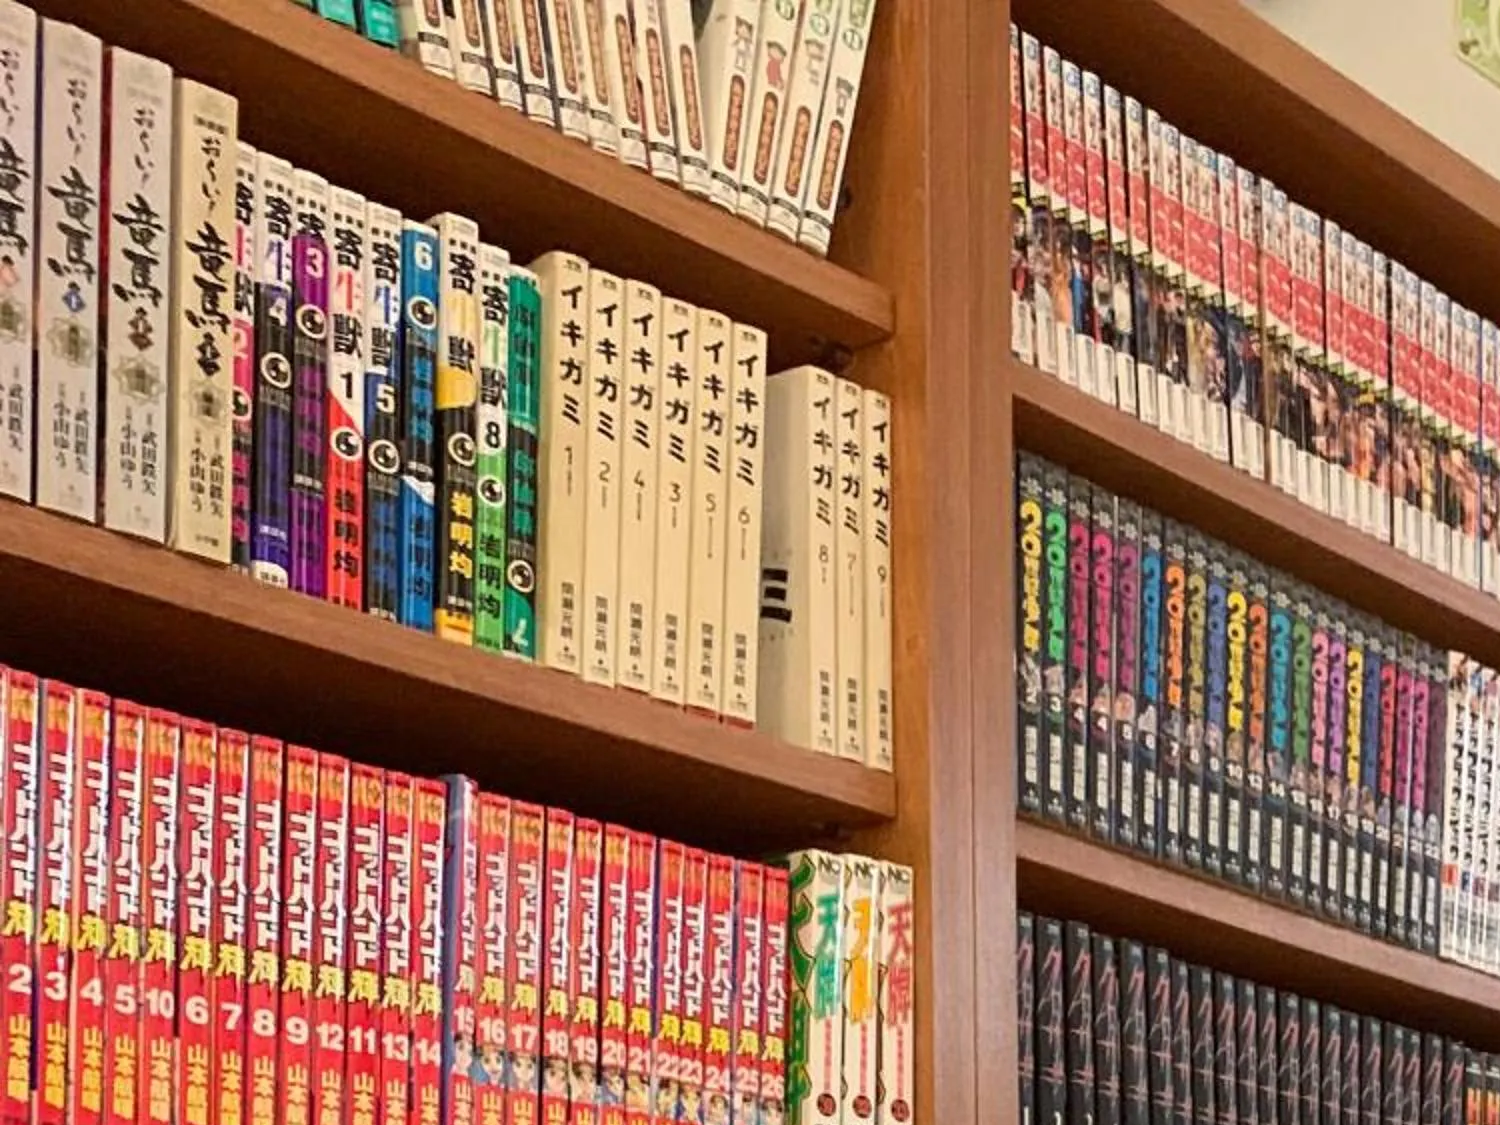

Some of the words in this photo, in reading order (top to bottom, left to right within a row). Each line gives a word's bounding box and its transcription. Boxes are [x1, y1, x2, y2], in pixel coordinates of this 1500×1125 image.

[415, 242, 433, 270] 6
[560, 284, 584, 425] イキガミ
[339, 371, 352, 399] 1
[595, 303, 618, 442] イキガミ
[630, 314, 654, 449] イキガミ
[666, 329, 691, 463] イキガミ
[701, 341, 725, 474] イキガミ
[485, 421, 501, 448] 8
[735, 355, 759, 487] イキガミ
[813, 398, 833, 525] イキガミ
[841, 407, 861, 536] イキガミ
[669, 483, 681, 502] 3
[872, 421, 890, 548] イキガミ
[8, 963, 32, 994] 2
[45, 971, 68, 1000] 3
[80, 977, 103, 1006] 4
[115, 984, 136, 1014] 5
[185, 996, 208, 1024] 6
[253, 1009, 276, 1036] 8
[317, 1022, 344, 1051] 12
[479, 1016, 505, 1043] 16
